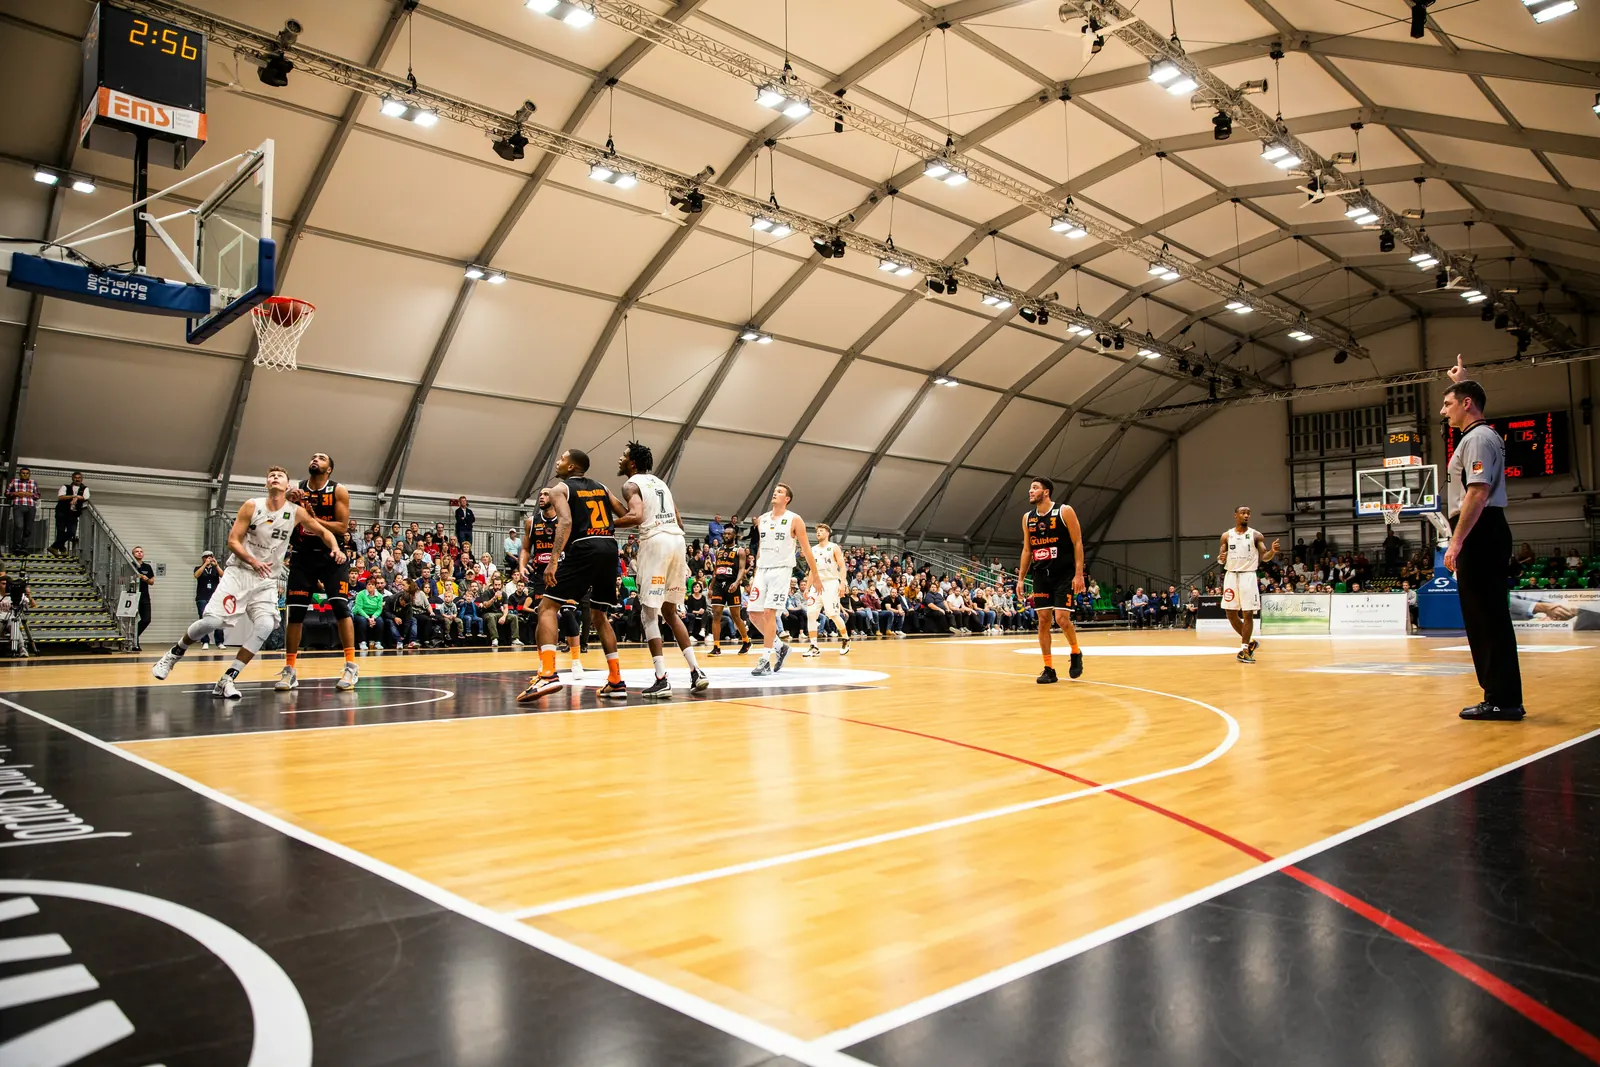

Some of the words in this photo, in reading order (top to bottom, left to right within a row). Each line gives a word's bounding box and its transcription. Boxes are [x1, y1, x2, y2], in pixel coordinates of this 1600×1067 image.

[129, 19, 197, 60] 2:56
[114, 95, 170, 127] EMS
[87, 273, 148, 293] Schelde
[87, 281, 147, 301] Sports
[1389, 433, 1410, 444] 2:56
[1522, 429, 1533, 440] 15
[321, 493, 333, 506] 31
[585, 500, 610, 529] 21
[1049, 516, 1057, 530] 3
[271, 528, 289, 541] 25
[774, 532, 786, 541] 35
[338, 581, 349, 595] 31
[124, 600, 132, 609] D
[773, 593, 786, 602] 35
[1065, 593, 1072, 607] 3
